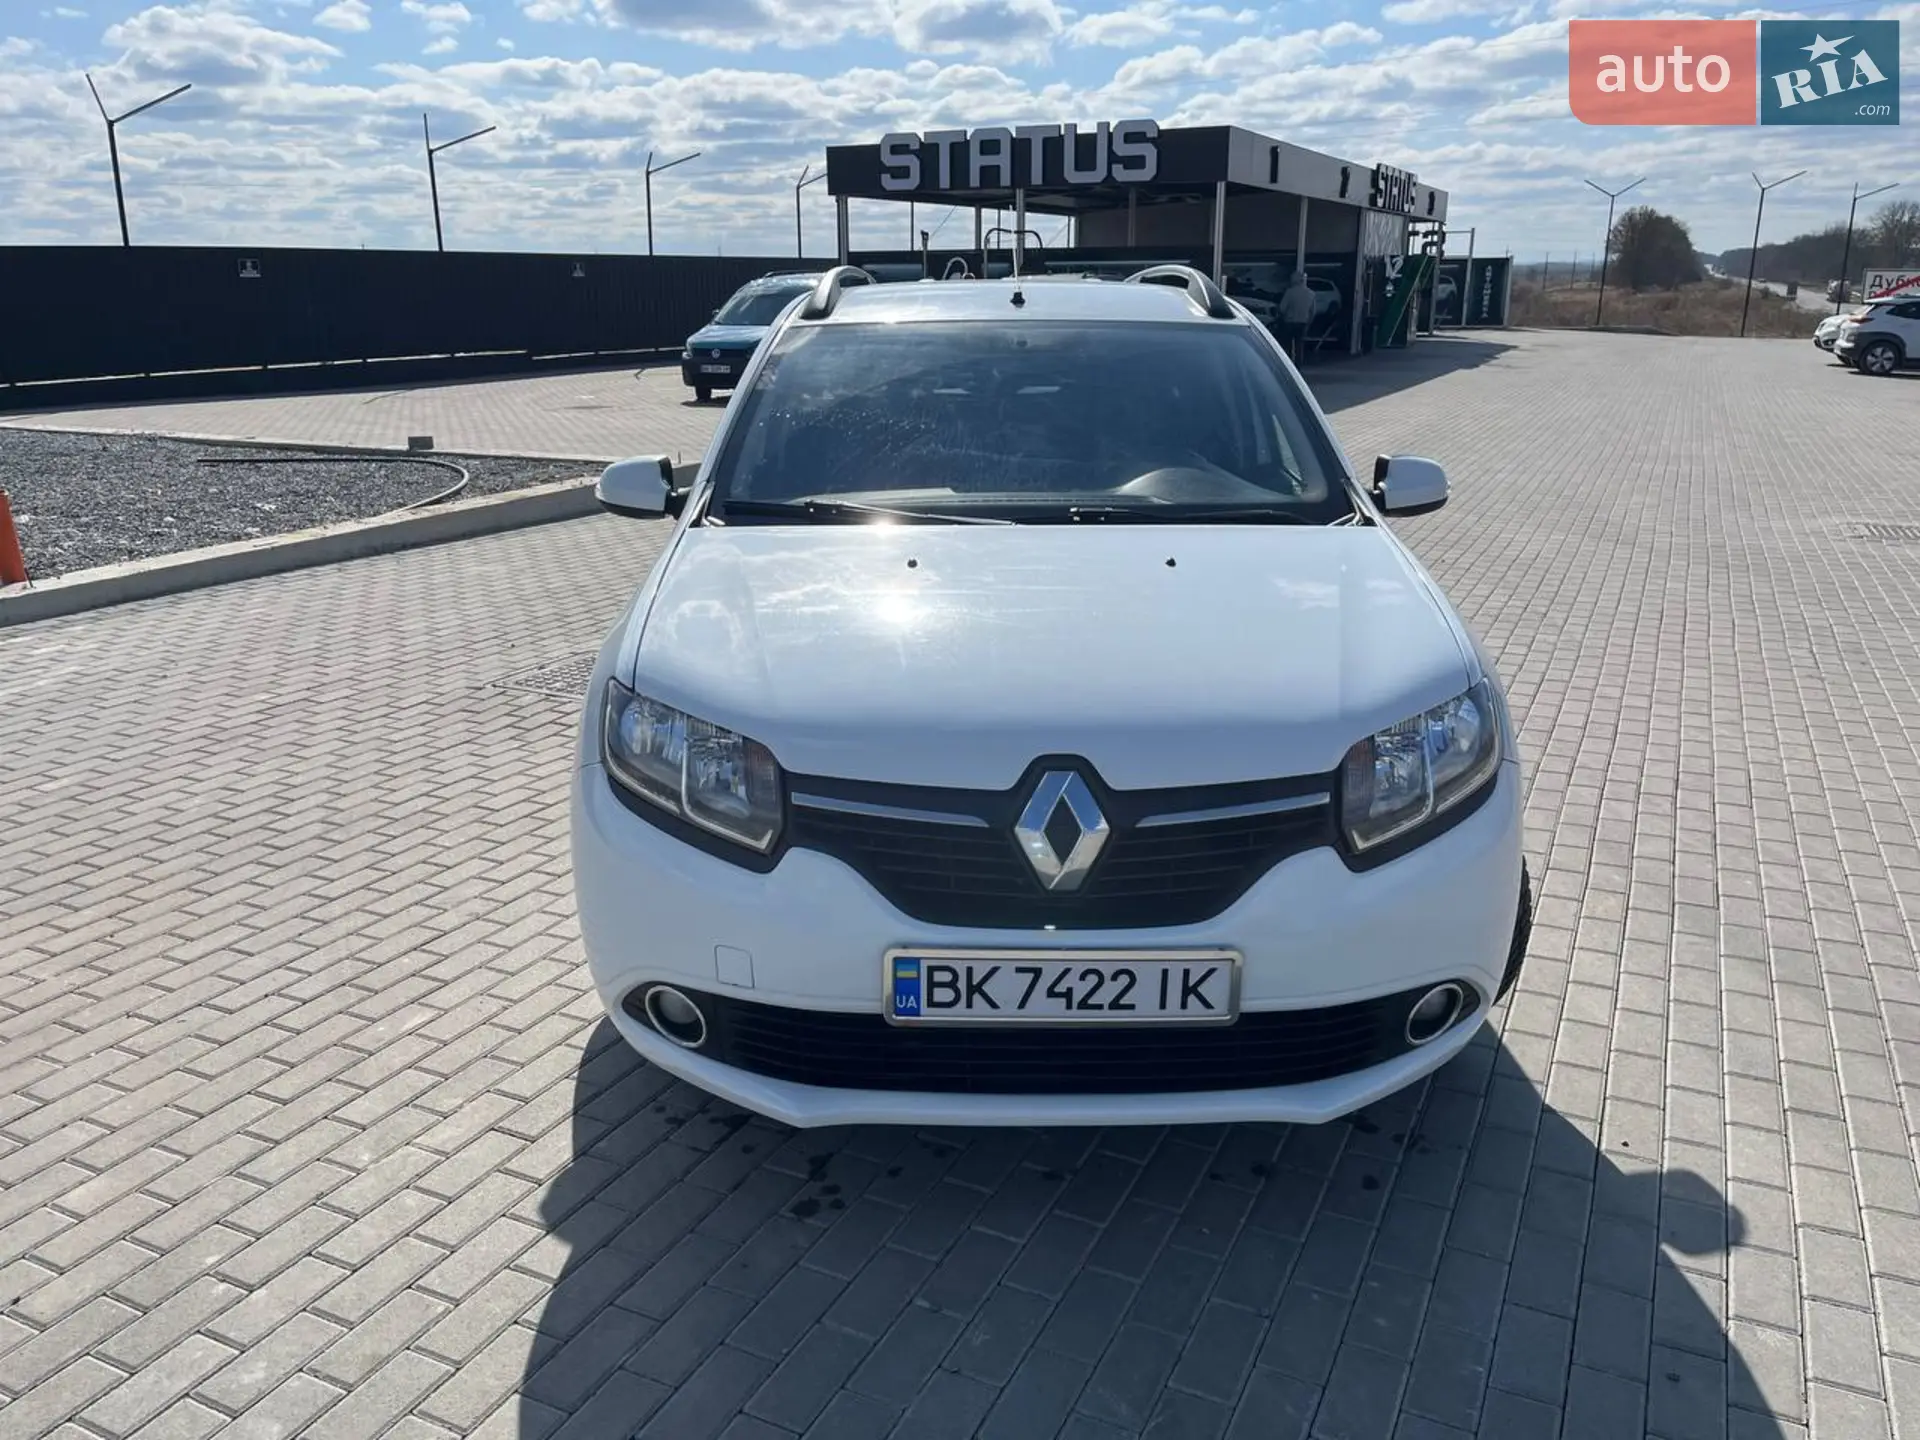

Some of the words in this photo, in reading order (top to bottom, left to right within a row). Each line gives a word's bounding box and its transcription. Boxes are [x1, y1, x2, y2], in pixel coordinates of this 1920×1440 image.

[879, 119, 1159, 191] STATUS
[1376, 163, 1418, 213] STATUS
[896, 995, 918, 1009] UA
[926, 965, 1002, 1010] BK
[1014, 967, 1138, 1010] 7422
[1159, 967, 1218, 1010] IK
